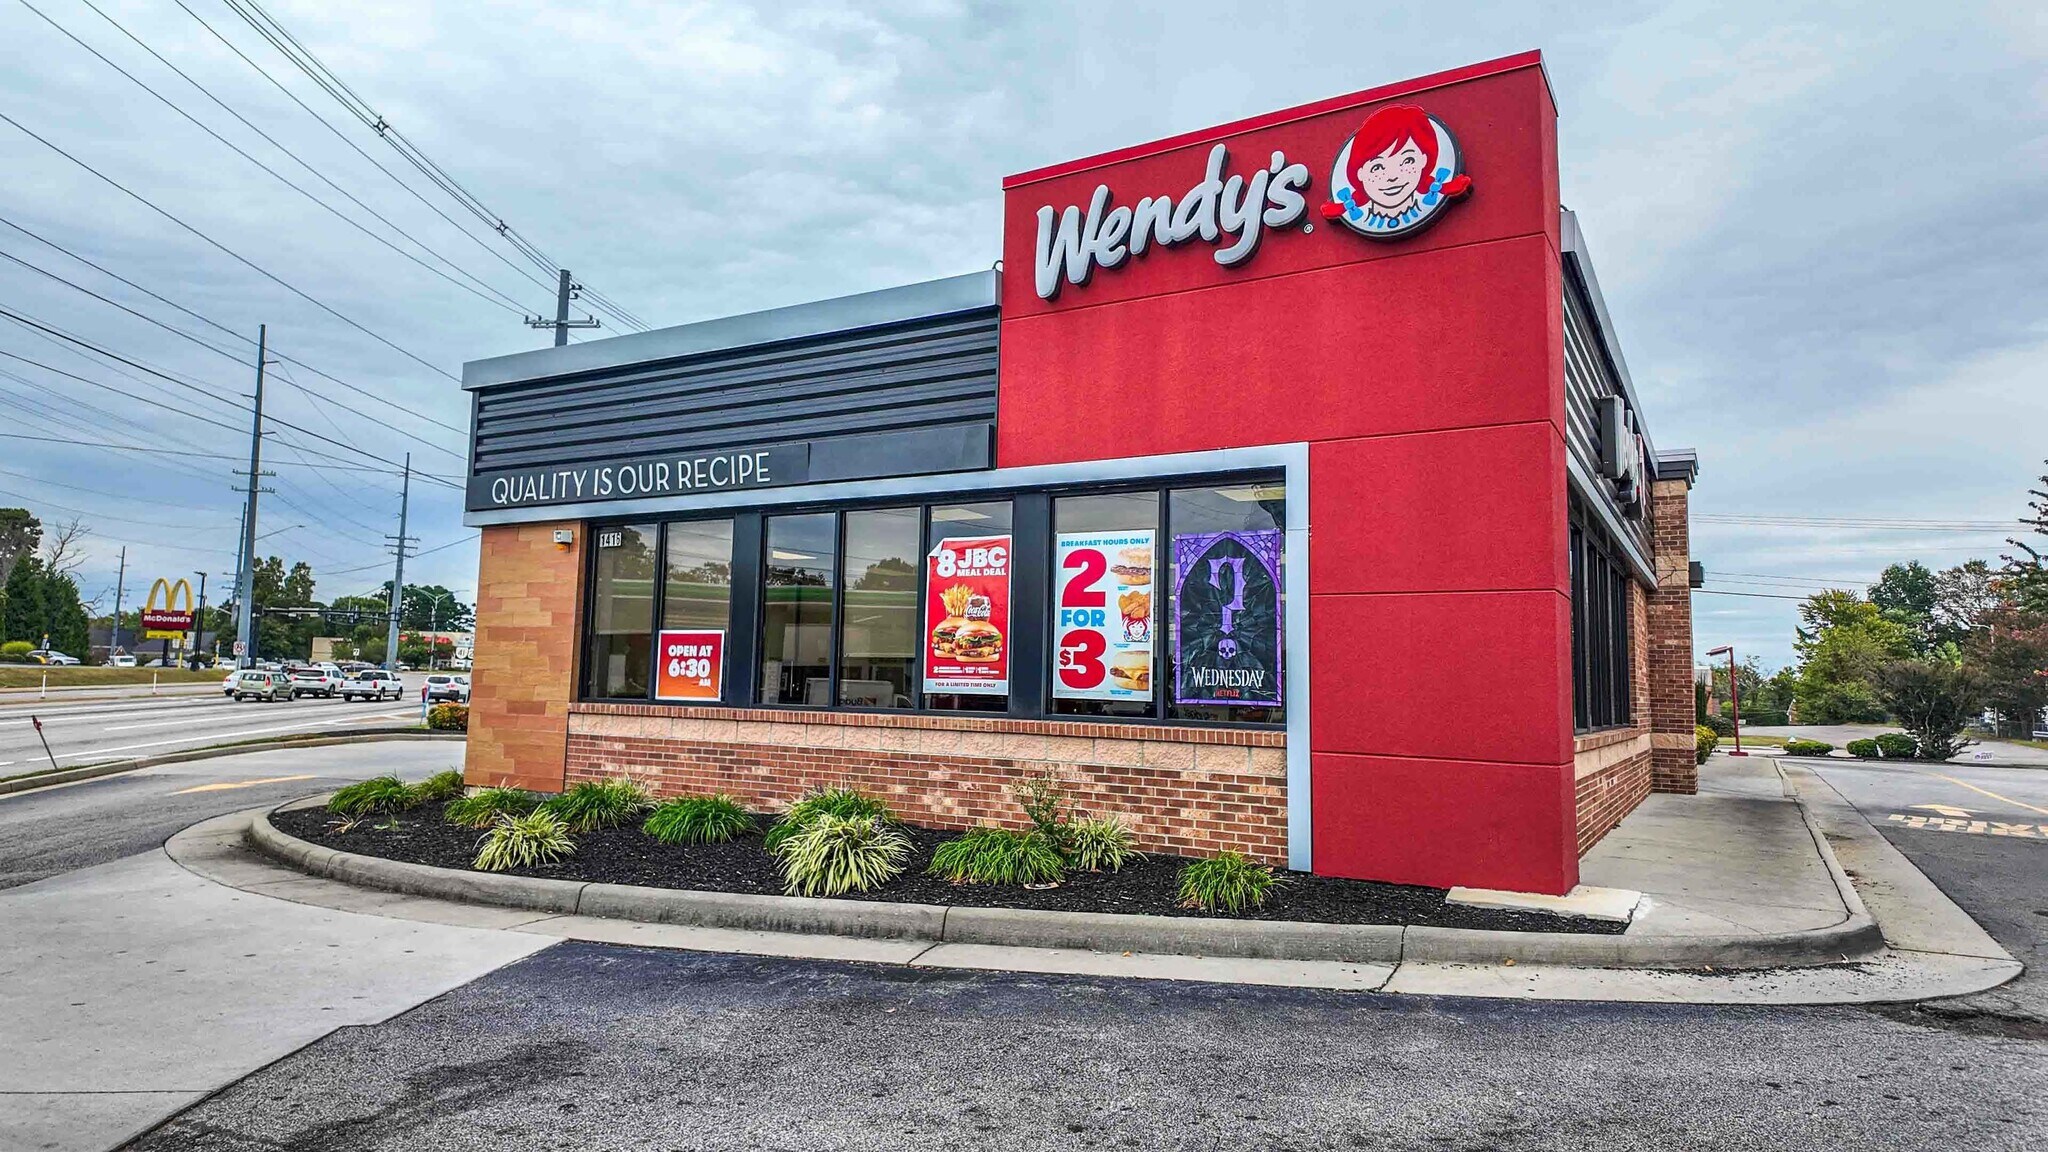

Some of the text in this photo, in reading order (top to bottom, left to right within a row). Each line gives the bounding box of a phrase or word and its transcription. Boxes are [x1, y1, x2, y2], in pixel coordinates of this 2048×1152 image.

[1035, 143, 1310, 299] Wendy's
[491, 452, 771, 505] QUALITY IS OUR RECIPE
[957, 546, 1007, 568] JBC
[957, 567, 1006, 577] MEAL DEAL
[1061, 548, 1107, 608] 2
[143, 615, 191, 623] McDonald's
[1061, 609, 1106, 628] FOR
[668, 645, 714, 657] OPEN AT
[668, 658, 711, 678] 6:30
[1191, 666, 1266, 689] WEDNESDAY
[1215, 689, 1240, 698] NETFLIX
